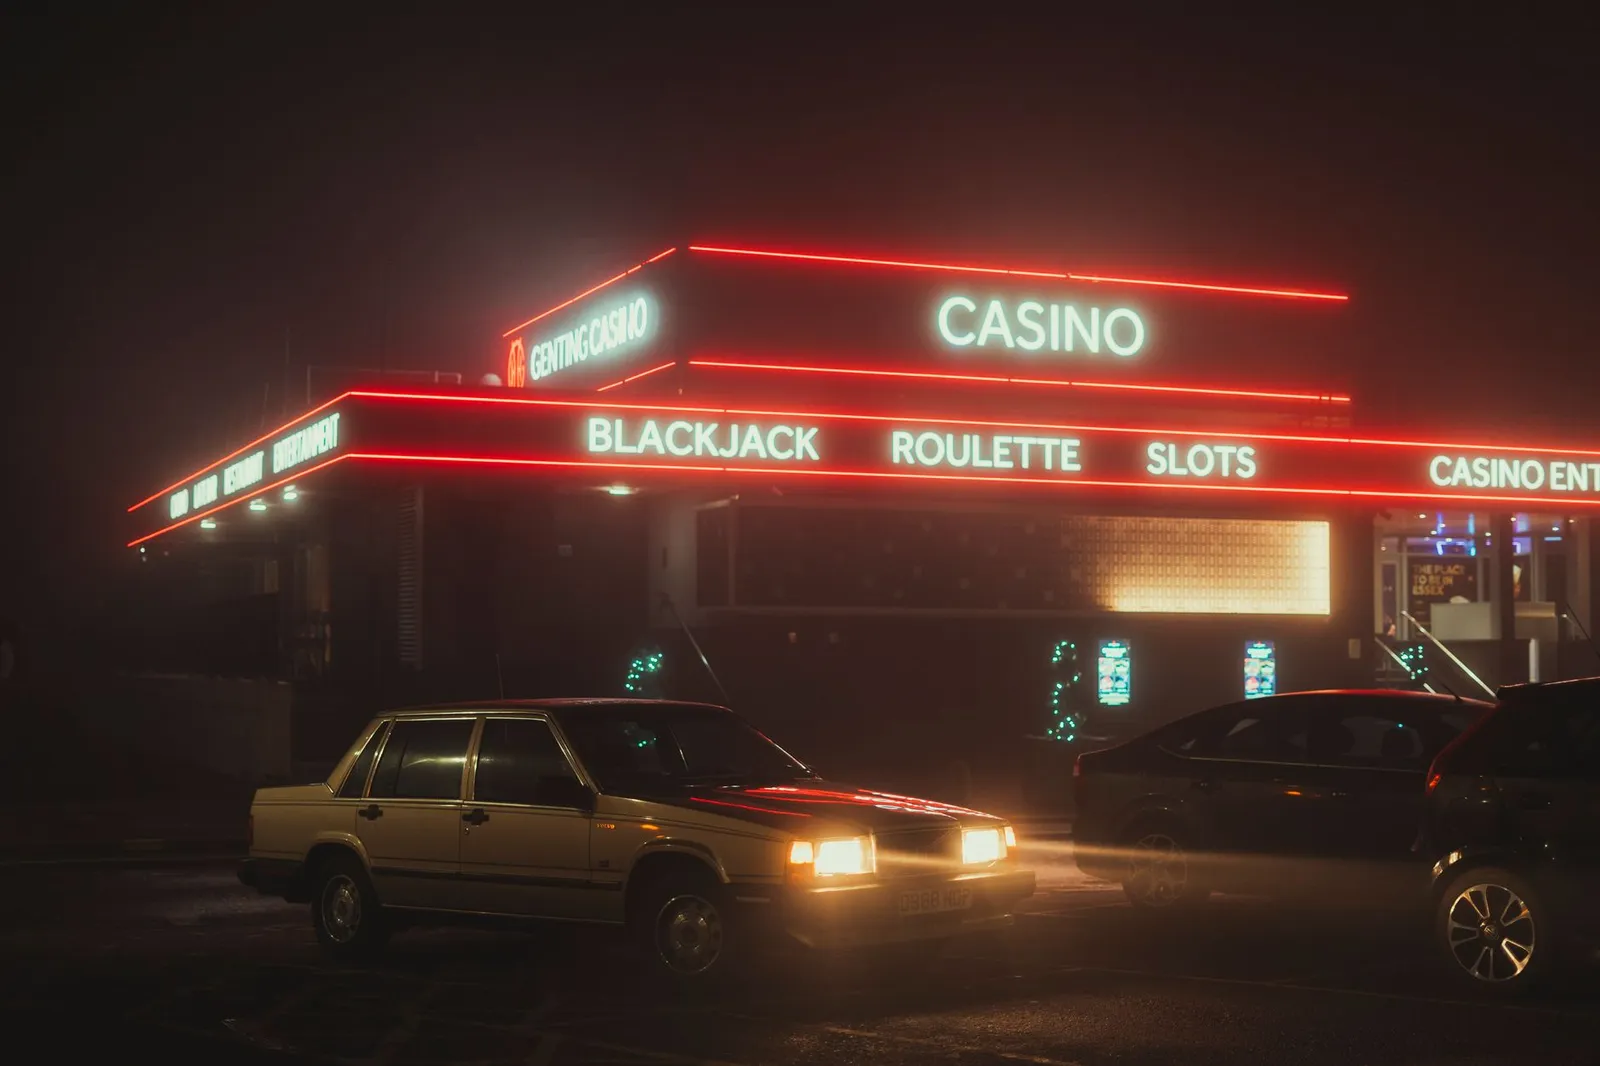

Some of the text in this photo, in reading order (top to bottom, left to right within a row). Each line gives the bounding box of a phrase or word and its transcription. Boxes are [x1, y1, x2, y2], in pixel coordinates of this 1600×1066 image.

[530, 297, 647, 380] GENTING CASINO
[938, 296, 1145, 356] CASINO
[588, 417, 820, 460] BLACKJACK
[892, 431, 1081, 471] ROULETTE
[1147, 442, 1256, 478] SLOTS
[1429, 455, 1600, 492] CASINO ENT
[1412, 564, 1432, 575] THE
[1413, 574, 1427, 585] TO
[1412, 585, 1444, 596] ESSEX
